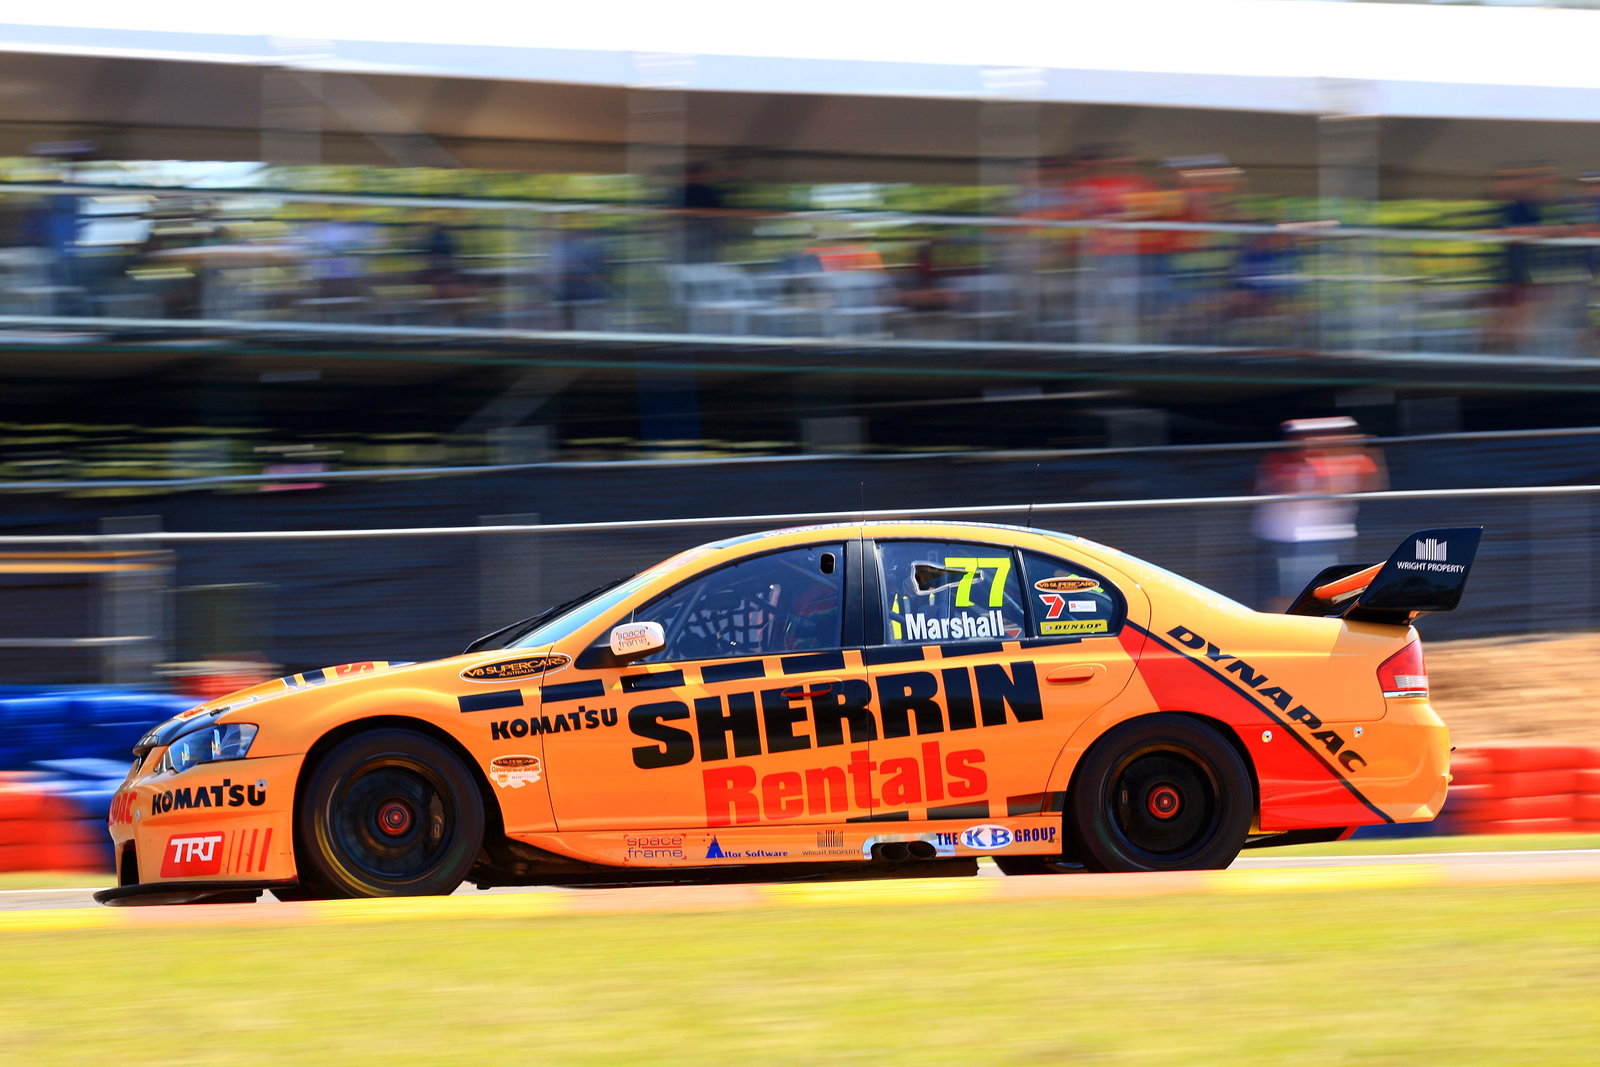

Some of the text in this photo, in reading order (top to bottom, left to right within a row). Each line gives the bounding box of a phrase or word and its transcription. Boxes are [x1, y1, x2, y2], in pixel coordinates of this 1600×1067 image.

[1397, 561, 1465, 573] WRIGHT PROPERTY
[944, 557, 1011, 607] 77
[617, 629, 646, 641] space
[904, 610, 1005, 640] Marshall
[466, 657, 565, 677] V8 SUPERCARS
[499, 668, 535, 677] AUSTRALIA
[1166, 625, 1367, 773] DYNAPAC
[490, 705, 618, 741] KOMATSU
[628, 660, 1043, 769] SHERRIN
[703, 741, 988, 827] Rentals
[151, 779, 266, 815] KOMATSU
[626, 835, 683, 848] space
[936, 827, 1056, 847] THE KB GROUP
[170, 835, 222, 863] TRT
[627, 847, 683, 859] frame
[745, 850, 788, 858] Software
[828, 848, 860, 856] PROPERTY
